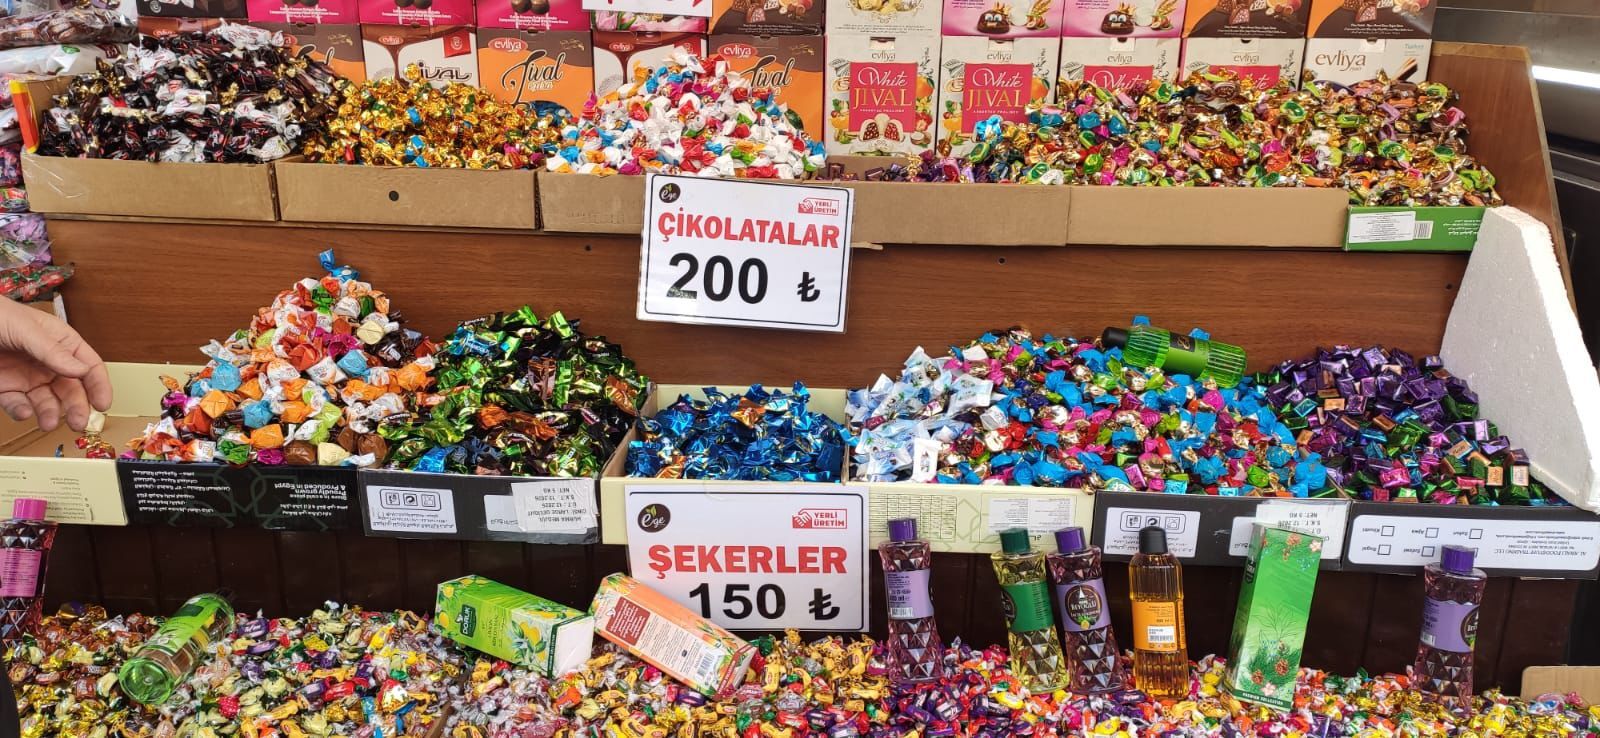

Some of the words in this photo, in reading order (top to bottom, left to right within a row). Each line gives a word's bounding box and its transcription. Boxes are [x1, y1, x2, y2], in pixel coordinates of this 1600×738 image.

[494, 39, 522, 52] evliya
[723, 45, 752, 58] evliya
[871, 51, 896, 62] evliya
[986, 51, 1012, 63] evliya
[1107, 53, 1133, 65] evliya
[1314, 49, 1366, 71] evliya
[857, 67, 909, 87] White
[972, 67, 1025, 88] White
[853, 88, 912, 109] JIVAL
[967, 90, 1025, 110] JIVAL
[657, 206, 840, 249] ÇİKOLATALAR
[666, 252, 769, 304] 200
[274, 482, 295, 490] Egypt
[813, 519, 845, 527] ÜRETİM
[814, 511, 838, 519] YERLİ
[648, 544, 848, 580] ŞEKERLER
[688, 583, 787, 620] 150
[462, 606, 471, 635] DORUK
